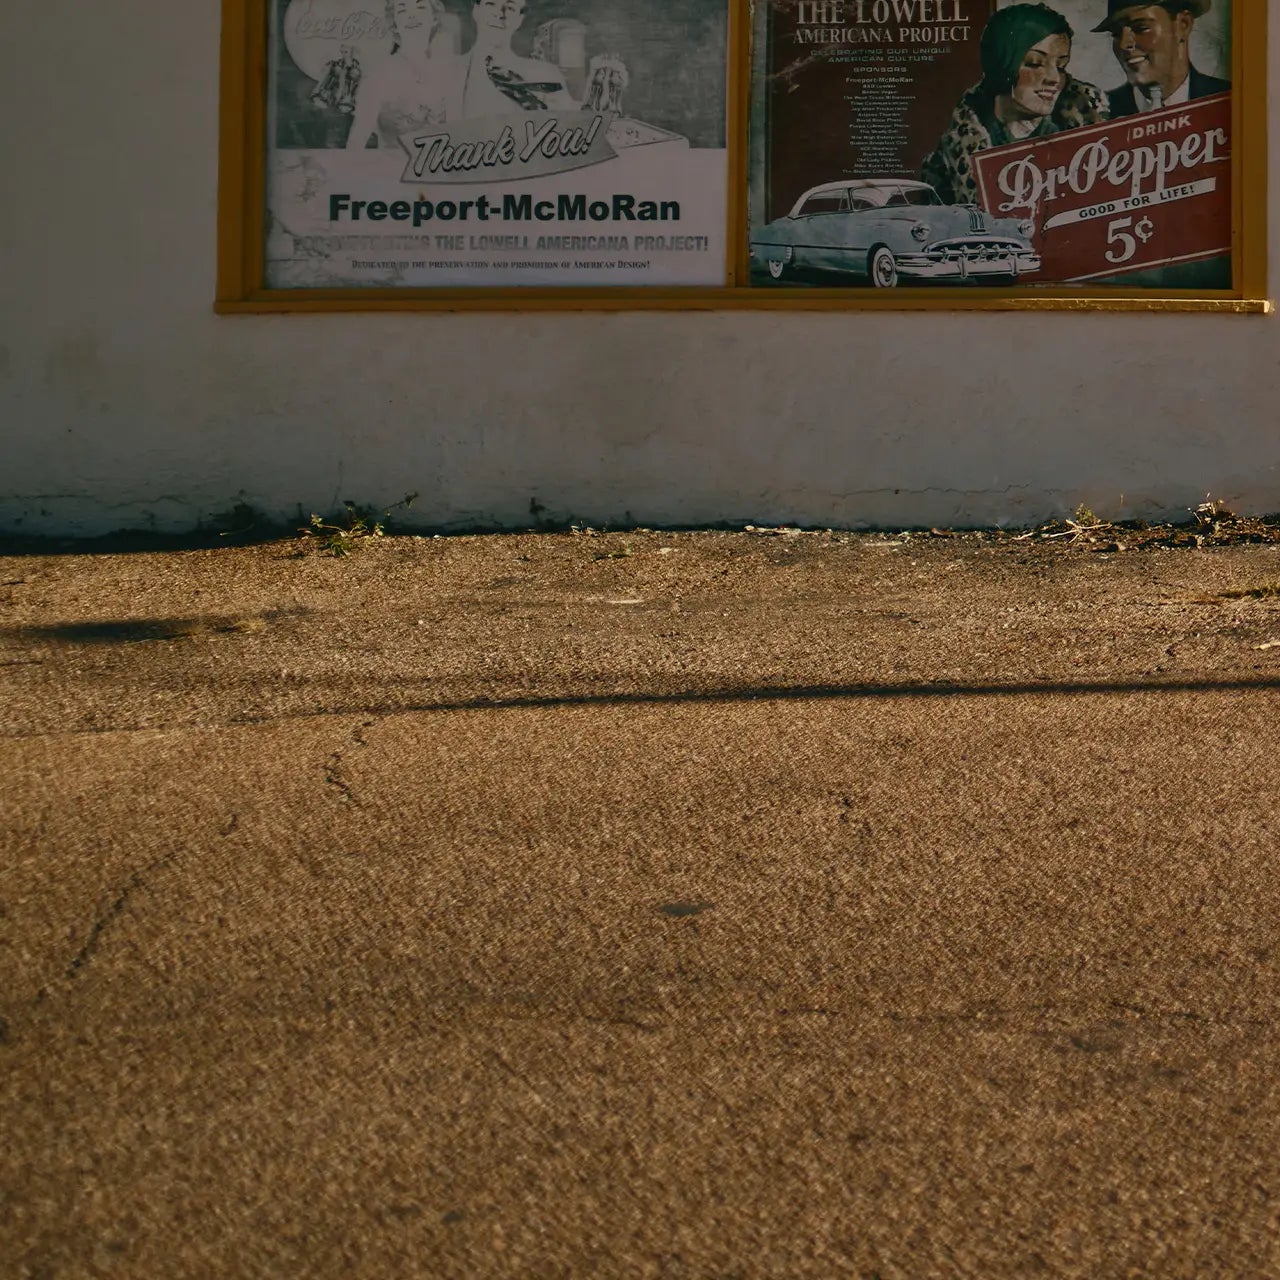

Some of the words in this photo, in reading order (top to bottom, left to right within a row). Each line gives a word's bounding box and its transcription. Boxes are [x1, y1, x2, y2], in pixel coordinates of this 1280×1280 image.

[797, 0, 845, 24] THE
[793, 28, 893, 44] AMERICANA
[899, 26, 970, 44] PROJECT
[888, 54, 934, 62] CULTURE
[1132, 115, 1192, 140] DRINK
[414, 125, 515, 177] Thank
[520, 115, 602, 162] You!
[1067, 128, 1228, 200] Pepper
[330, 194, 681, 226] Freeport-McMoRan
[1079, 203, 1116, 218] GOOD
[1124, 196, 1150, 209] FOR
[1160, 186, 1194, 201] LIFE!
[435, 235, 464, 250] THE
[470, 235, 528, 250] LOWELL
[536, 235, 629, 250] AMERICANA
[635, 235, 708, 250] PROJECT!
[1104, 215, 1154, 264] 5¢
